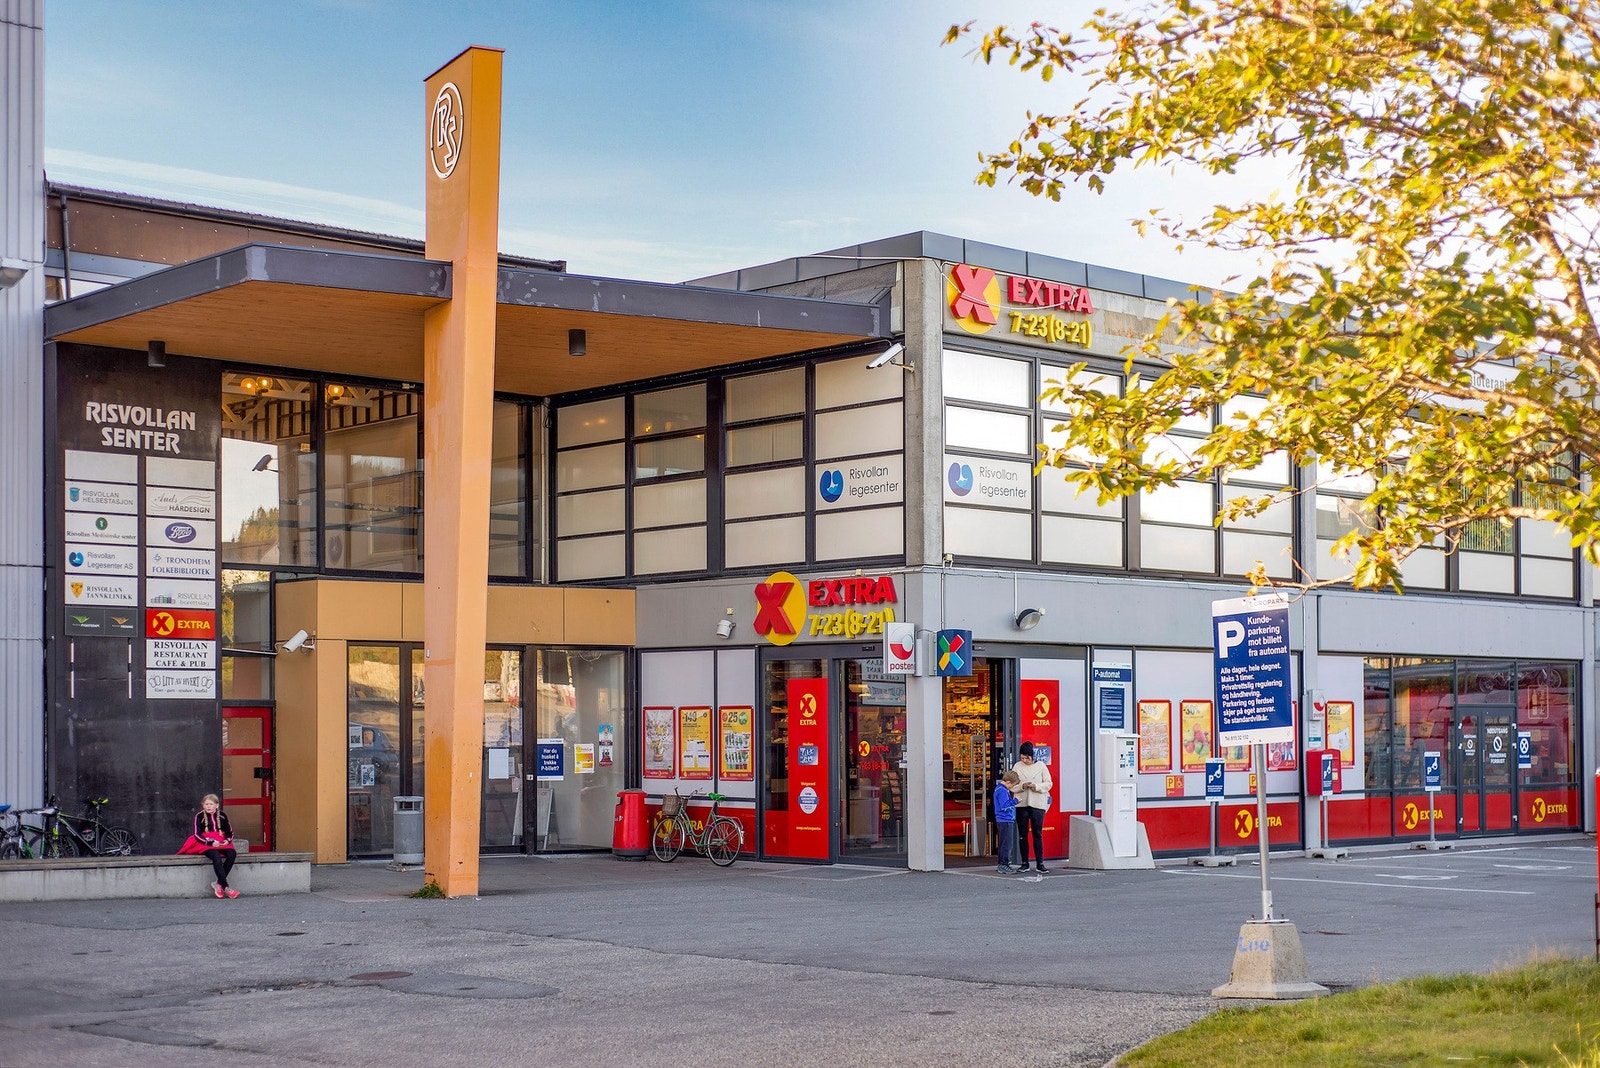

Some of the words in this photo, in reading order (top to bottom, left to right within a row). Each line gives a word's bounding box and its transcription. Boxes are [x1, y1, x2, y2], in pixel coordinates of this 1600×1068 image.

[1008, 276, 1094, 314] EXTRA
[86, 402, 196, 430] RISVOLLAN
[102, 427, 180, 454] SENTER
[849, 466, 888, 480] Risvollan
[979, 466, 1018, 481] Risvollan
[82, 490, 119, 498] RISVOLLAN
[849, 481, 899, 497] legesenter
[979, 484, 1027, 499] legesenter
[82, 497, 134, 505] HELSESTASJON
[169, 504, 210, 513] HÅRDESIGN
[166, 557, 210, 565] TRONDHEIM
[152, 566, 210, 575] FOLKEBIBLIOTEK
[808, 576, 898, 607] EXTRA
[177, 620, 210, 629] EXTRA
[1247, 615, 1272, 625] Kunde-
[1248, 625, 1280, 637] parkering
[154, 641, 208, 649] RISVOLLAN
[1218, 621, 1245, 658] P
[1248, 638, 1262, 646] mot
[1263, 635, 1282, 644] billett
[1248, 649, 1258, 657] fra
[1259, 646, 1287, 656] automat
[1255, 680, 1282, 689] regulering
[1256, 696, 1274, 704] ferdsel
[1237, 708, 1243, 716] på
[1244, 707, 1255, 715] eget
[1547, 804, 1568, 814] EXTRA
[1420, 810, 1444, 821] EXRA
[1255, 816, 1282, 828] ETRA
